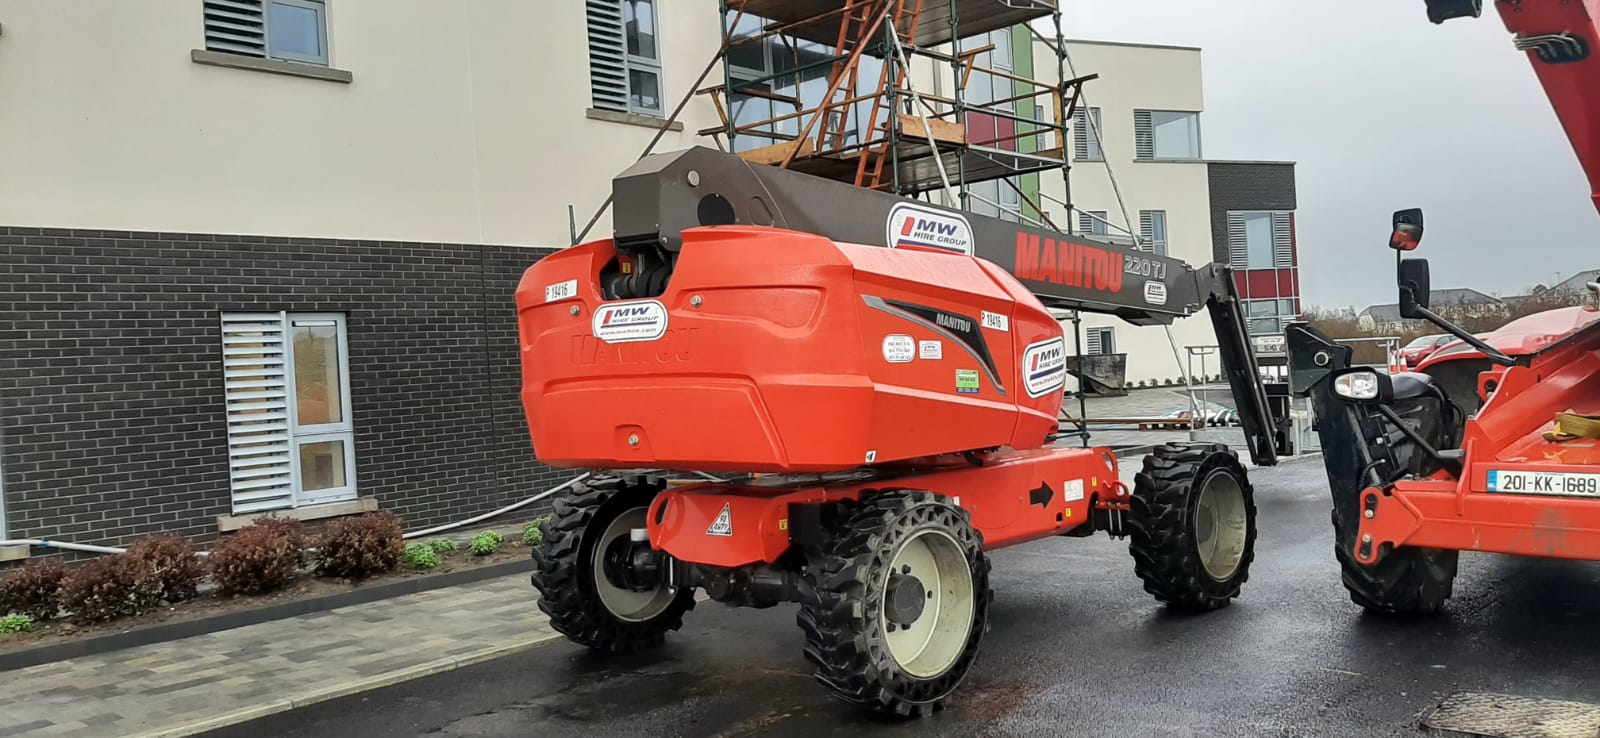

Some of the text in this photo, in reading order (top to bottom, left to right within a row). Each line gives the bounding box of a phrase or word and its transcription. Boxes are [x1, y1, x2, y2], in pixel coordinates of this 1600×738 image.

[917, 219, 957, 236] MW
[914, 231, 967, 246] HIRE GROUP
[1015, 231, 1124, 293] MANITOU
[1123, 255, 1167, 279] 220 TJ
[551, 283, 568, 299] 19416
[614, 306, 650, 317] MW
[936, 313, 971, 333] MANITOU
[986, 313, 1002, 328] 19416
[1040, 347, 1060, 362] MW
[1039, 361, 1051, 369] HIRE
[1503, 474, 1597, 493] 201-KK-1689
